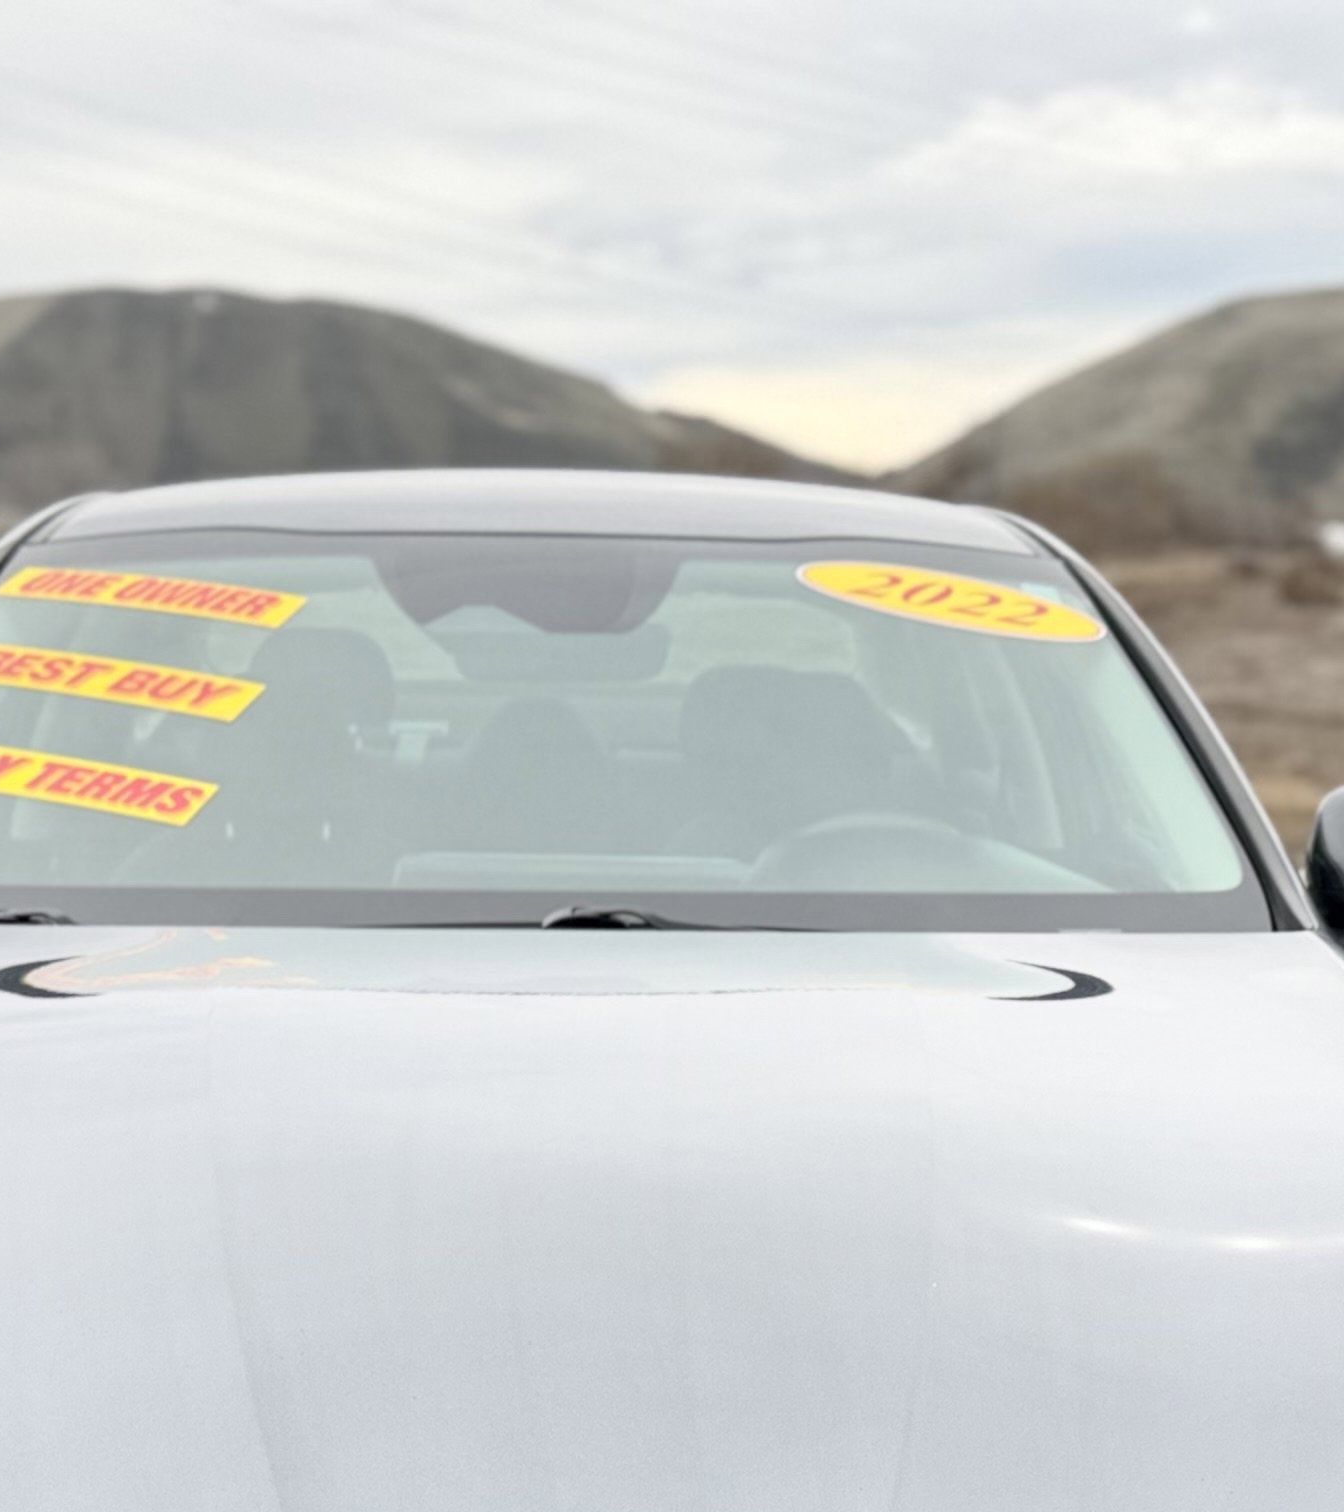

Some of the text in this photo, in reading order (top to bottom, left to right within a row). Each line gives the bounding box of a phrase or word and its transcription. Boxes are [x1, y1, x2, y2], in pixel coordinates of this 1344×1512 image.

[20, 571, 284, 618] ONE OWNER
[848, 571, 1049, 627] 2022
[106, 669, 242, 709] BUY
[24, 761, 205, 817] TERMS
